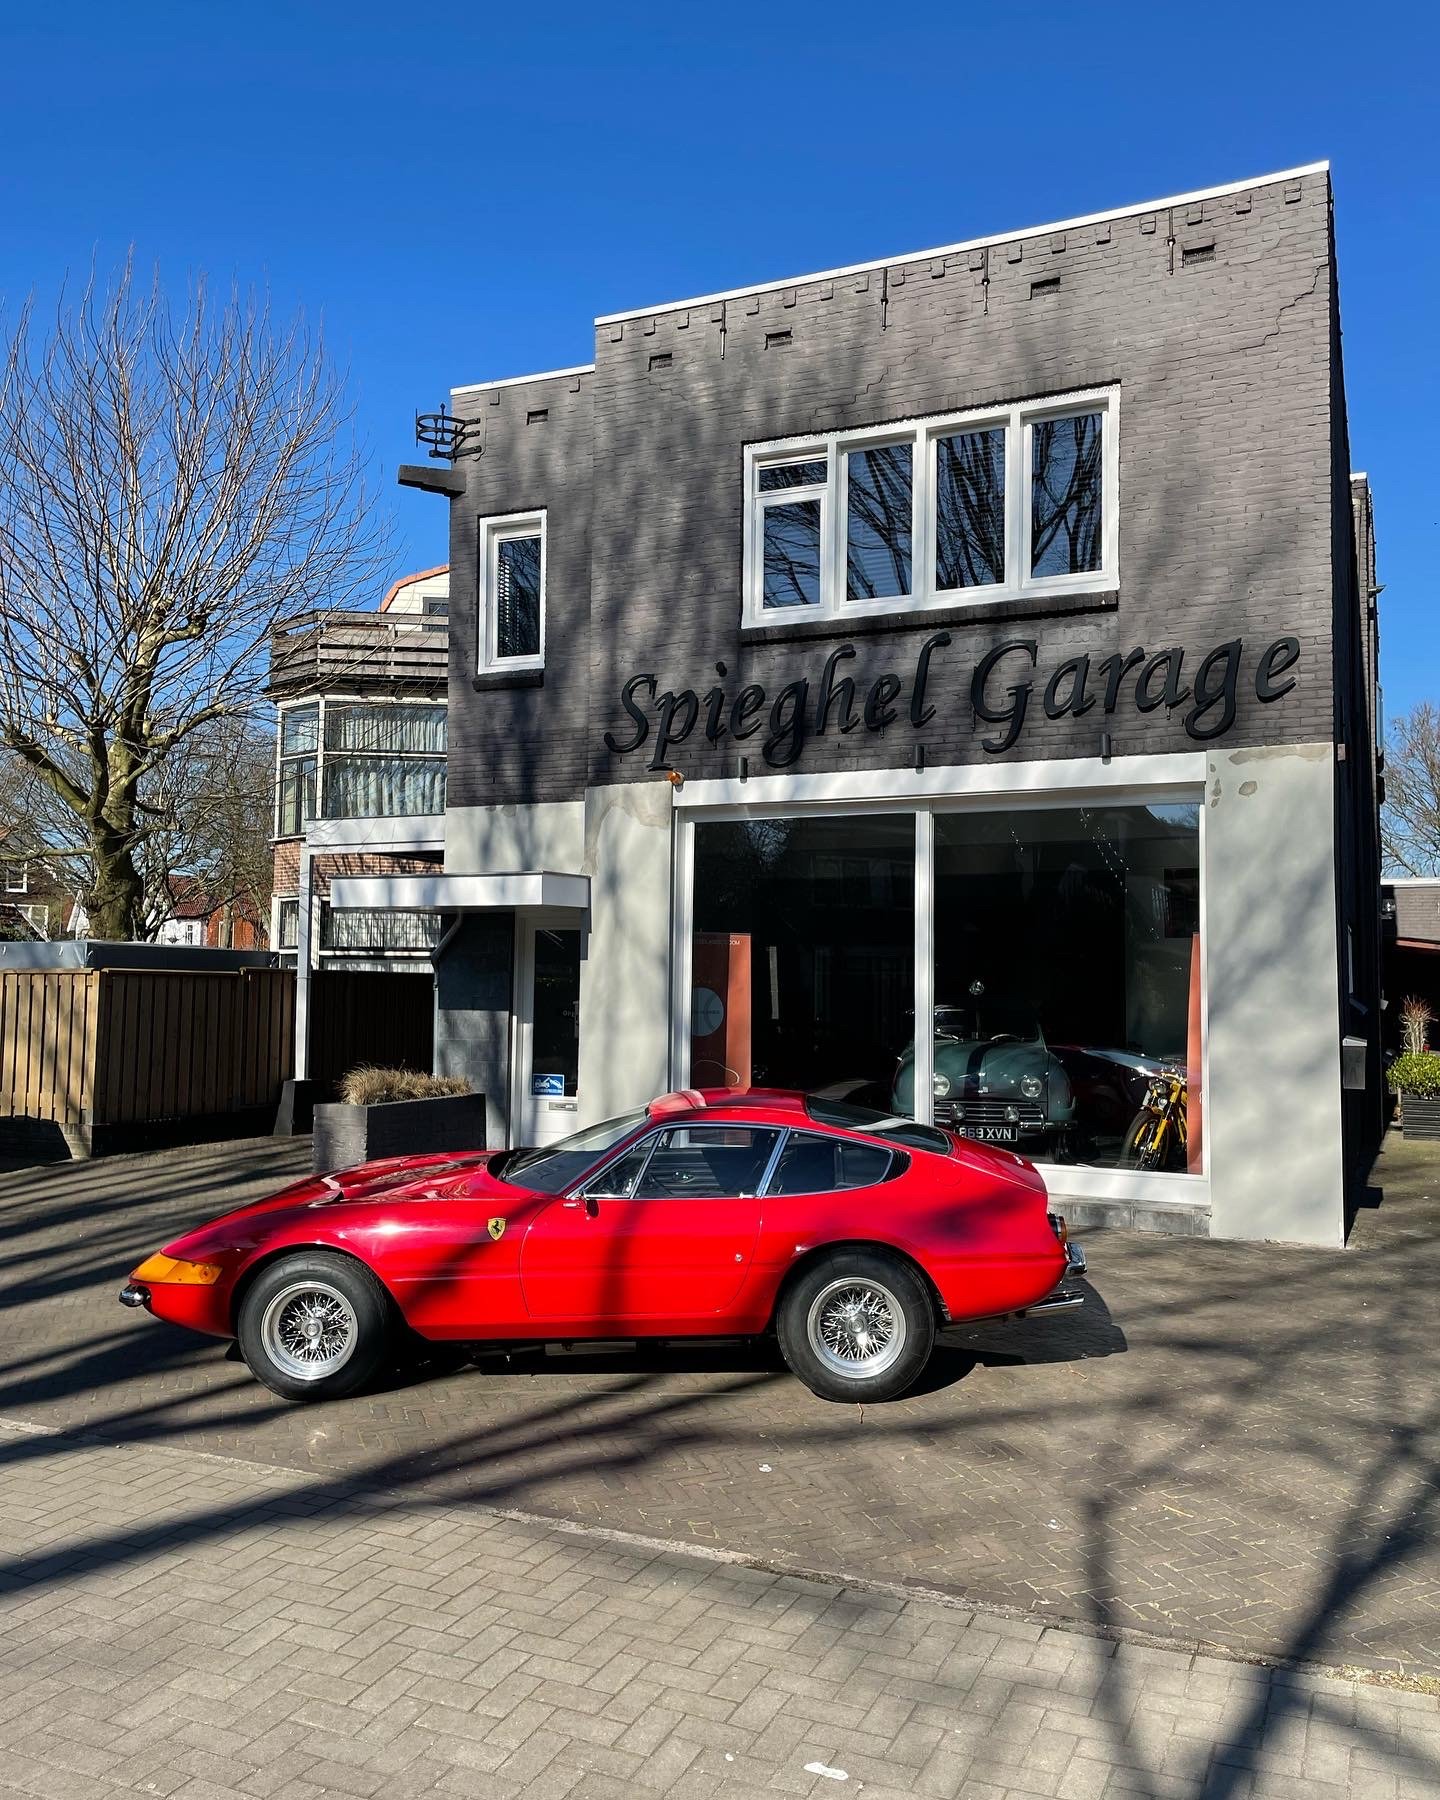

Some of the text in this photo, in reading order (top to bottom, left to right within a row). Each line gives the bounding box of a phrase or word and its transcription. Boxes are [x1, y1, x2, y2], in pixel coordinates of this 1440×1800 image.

[604, 632, 1300, 772] Spieghel Garage
[986, 1128, 1012, 1140] XVN
